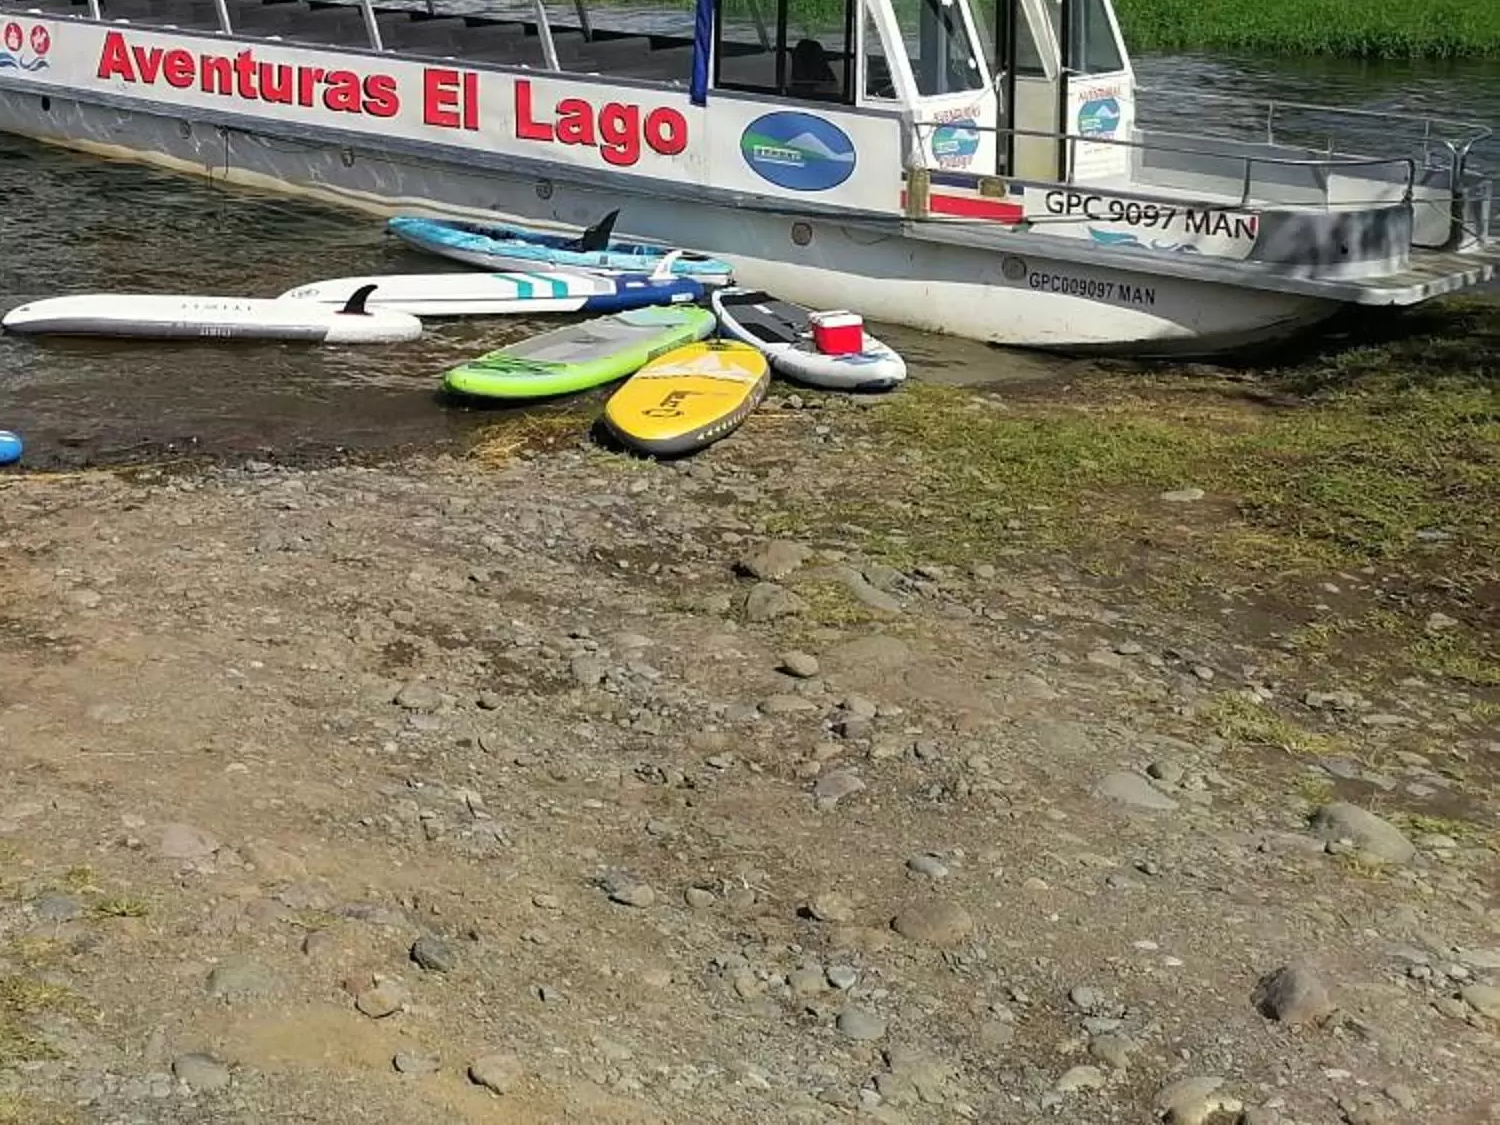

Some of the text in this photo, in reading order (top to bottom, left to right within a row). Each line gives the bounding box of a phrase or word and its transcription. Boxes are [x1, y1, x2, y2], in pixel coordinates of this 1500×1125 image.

[97, 30, 689, 167] Aventuras El Lago
[1045, 190, 1258, 240] GPC 9097 MAN
[1029, 272, 1156, 305] GPC009097 MAN
